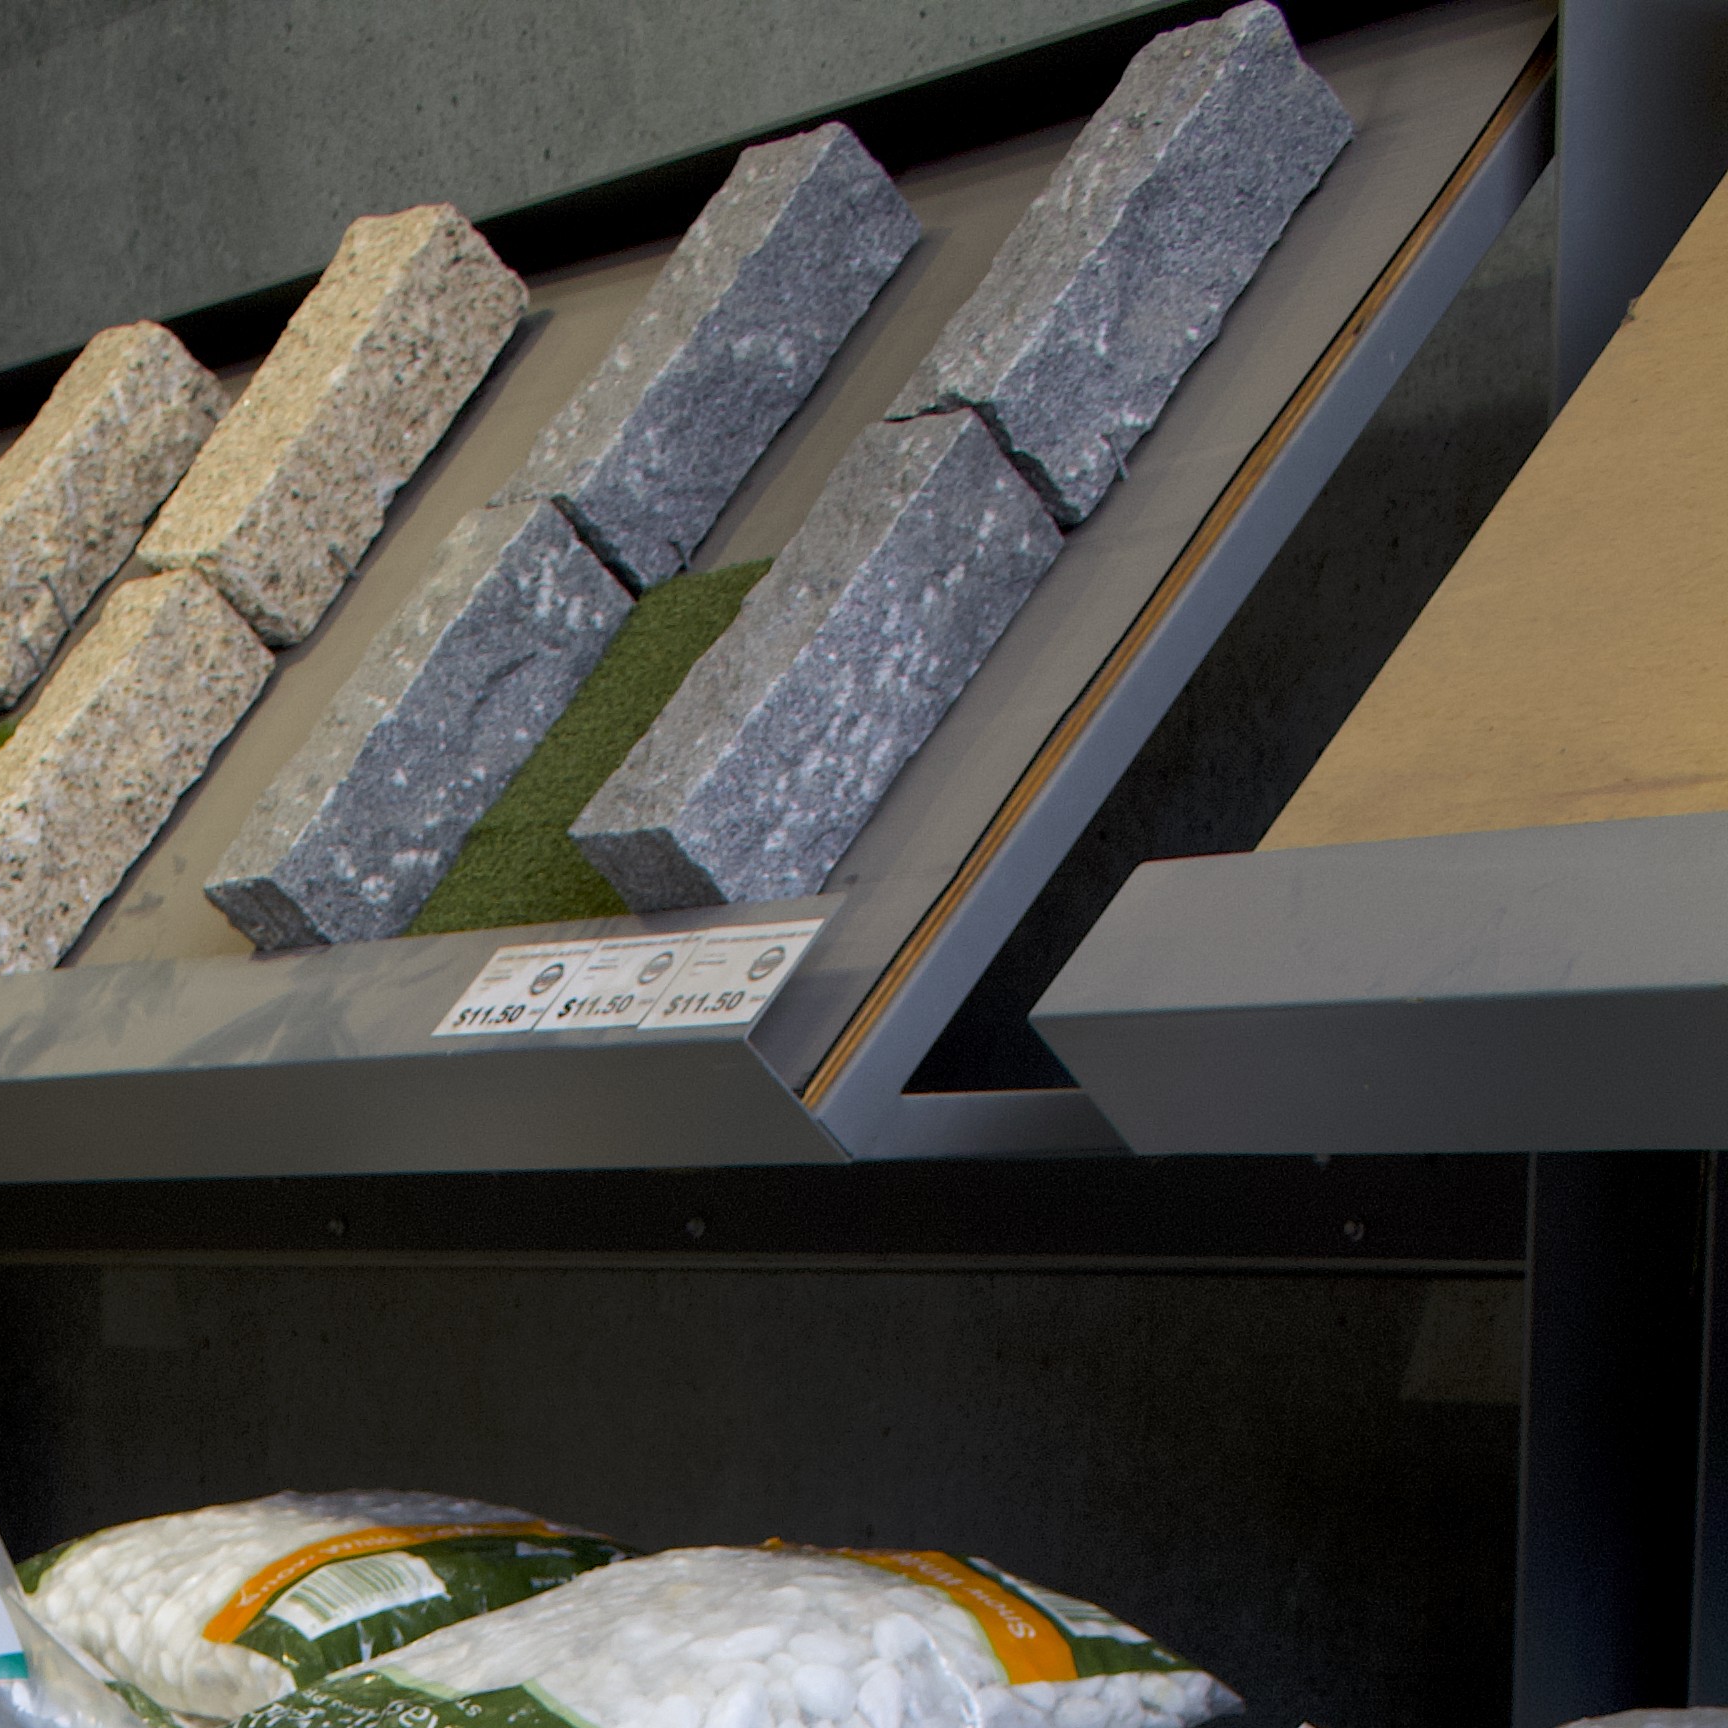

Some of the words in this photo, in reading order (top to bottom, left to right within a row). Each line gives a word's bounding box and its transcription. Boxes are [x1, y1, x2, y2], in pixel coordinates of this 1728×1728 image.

[451, 1003, 525, 1028] $11.50
[556, 993, 634, 1019] $11.50
[663, 989, 744, 1017] $11.50
